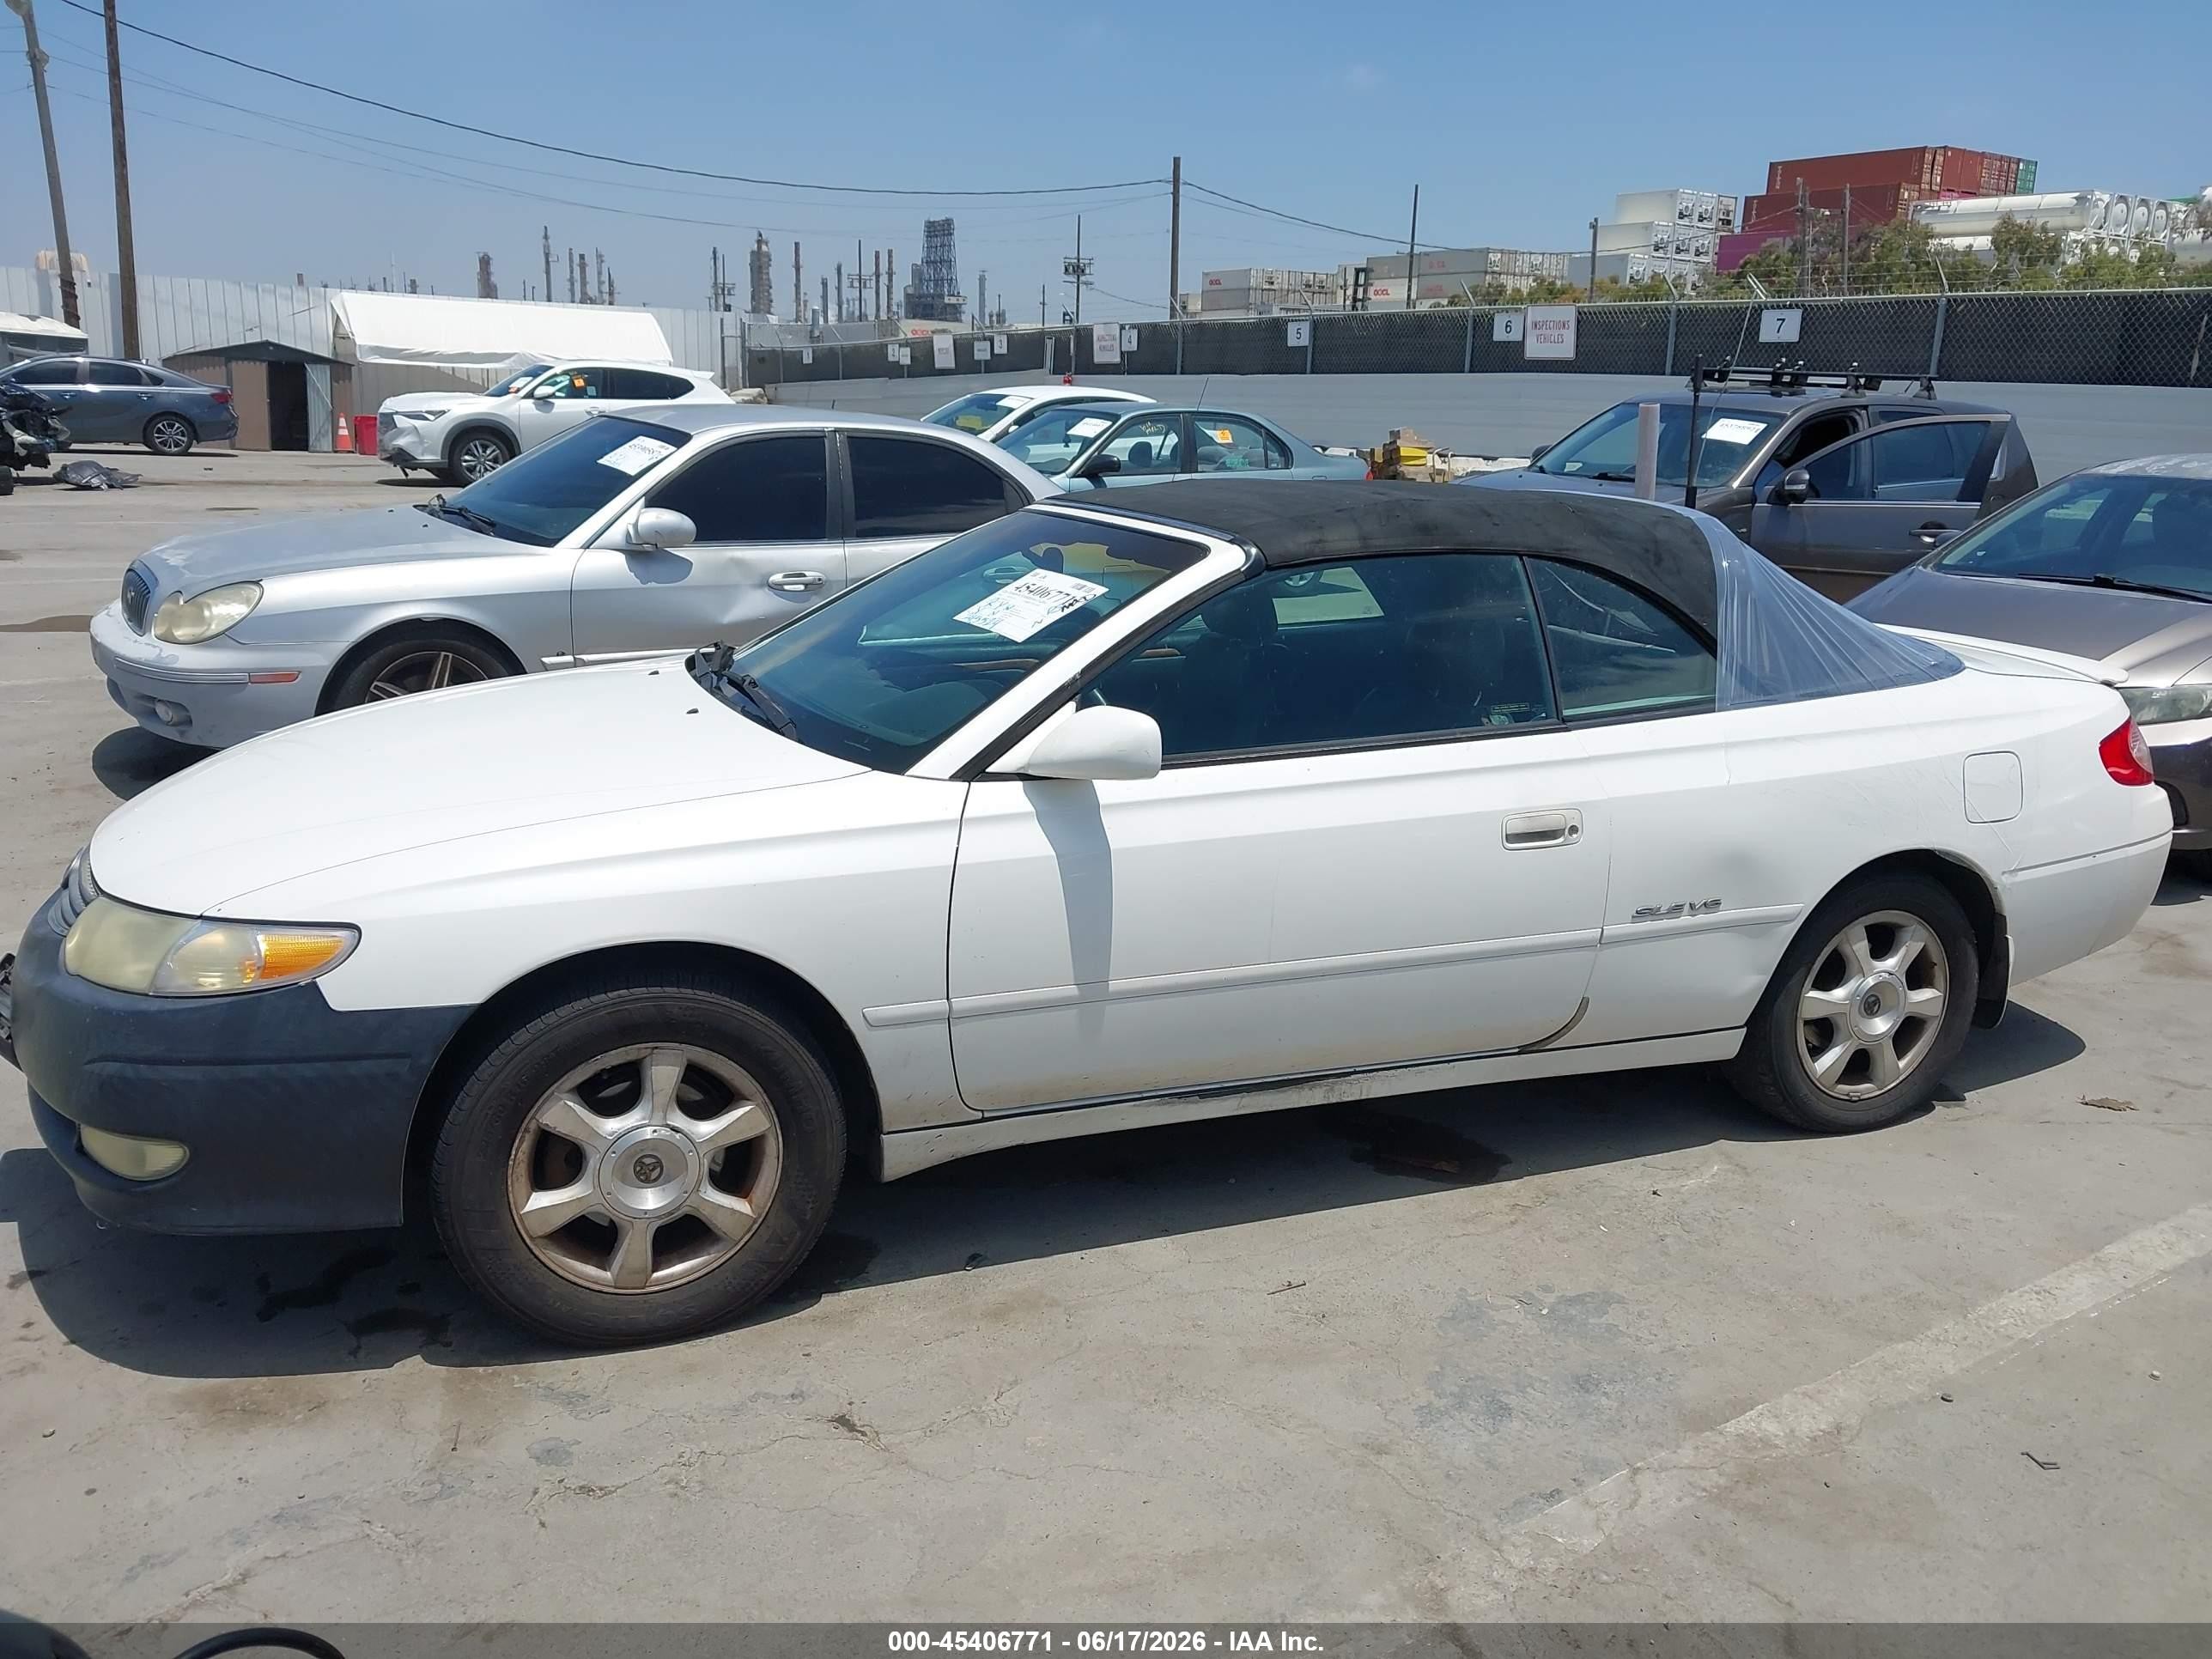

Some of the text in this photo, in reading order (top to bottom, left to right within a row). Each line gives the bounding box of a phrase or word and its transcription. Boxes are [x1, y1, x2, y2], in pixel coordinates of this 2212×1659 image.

[1504, 319, 1512, 334] 6
[1531, 319, 1571, 331] INSPECTIONS
[1776, 318, 1786, 334] 7
[1127, 334, 1133, 345] 4
[1296, 327, 1302, 340] 5
[1535, 333, 1565, 344] VEHICLES
